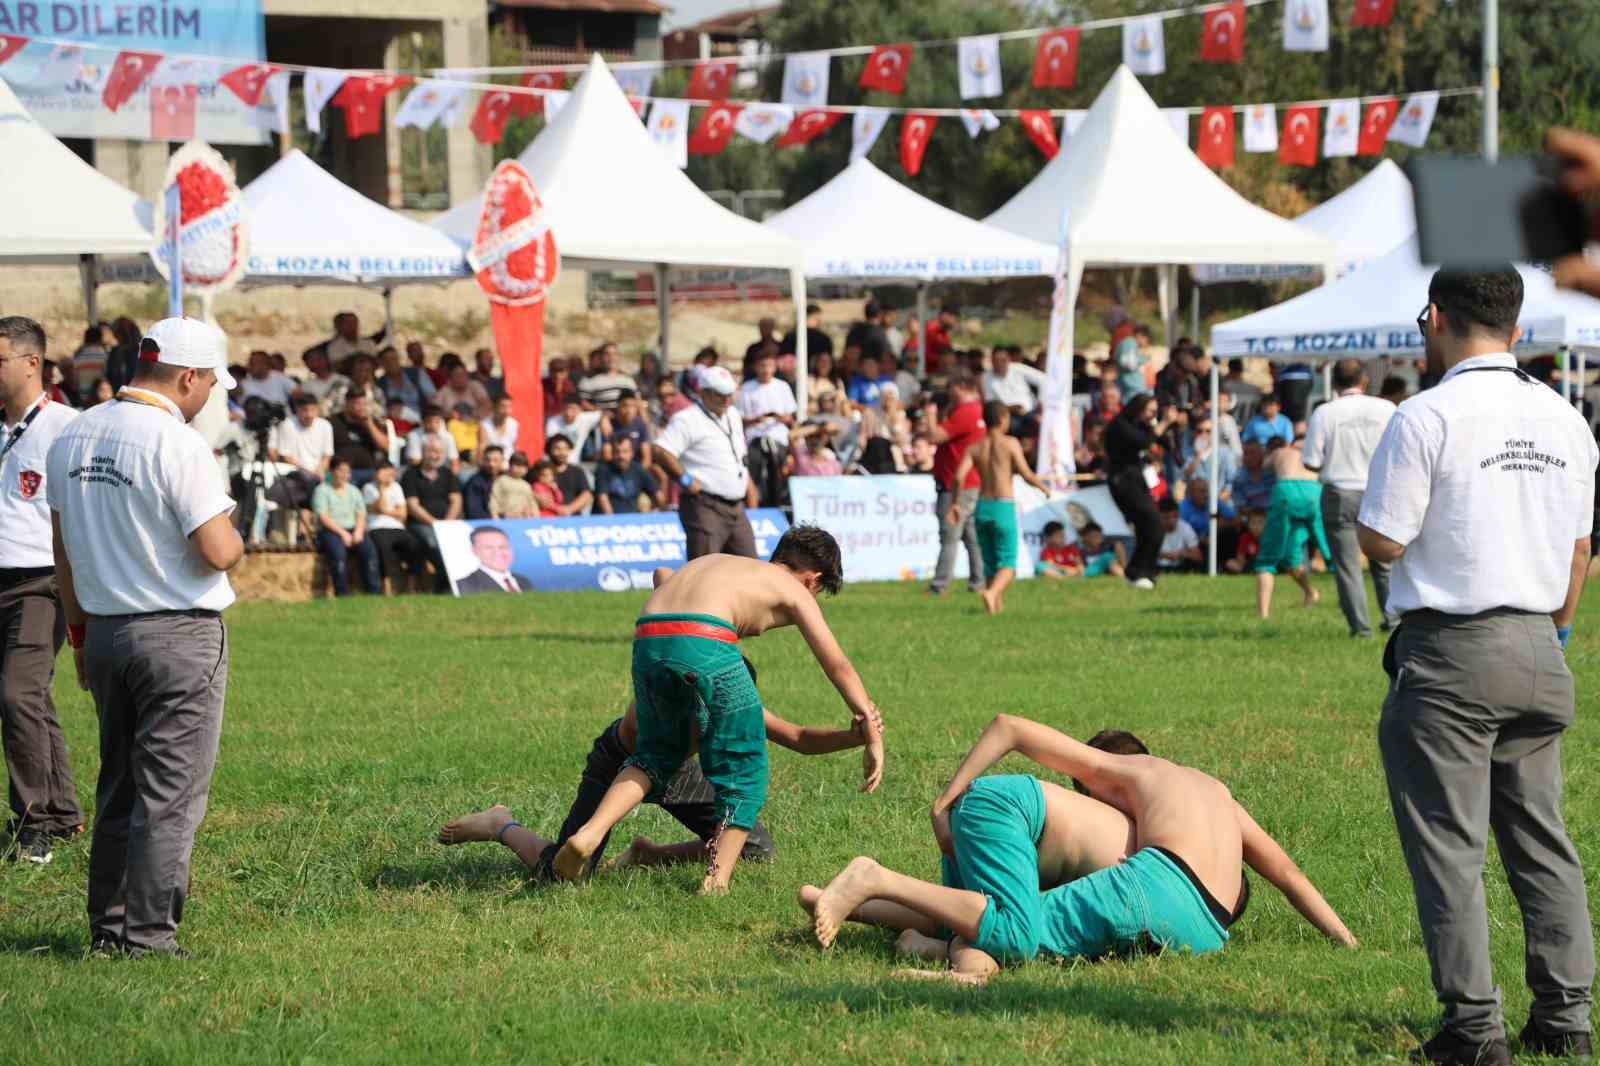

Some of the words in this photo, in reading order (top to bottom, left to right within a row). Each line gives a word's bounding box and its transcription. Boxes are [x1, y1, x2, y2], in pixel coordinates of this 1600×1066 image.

[51, 1, 200, 37] DİLERİM
[277, 256, 352, 272] KOZAN
[864, 258, 928, 273] KOZAN
[1244, 336, 1285, 354] T.C.
[1293, 333, 1377, 351] KOZAN
[808, 494, 865, 516] Tüm
[525, 524, 578, 547] TÜM
[549, 543, 682, 567] BAŞARILAR
